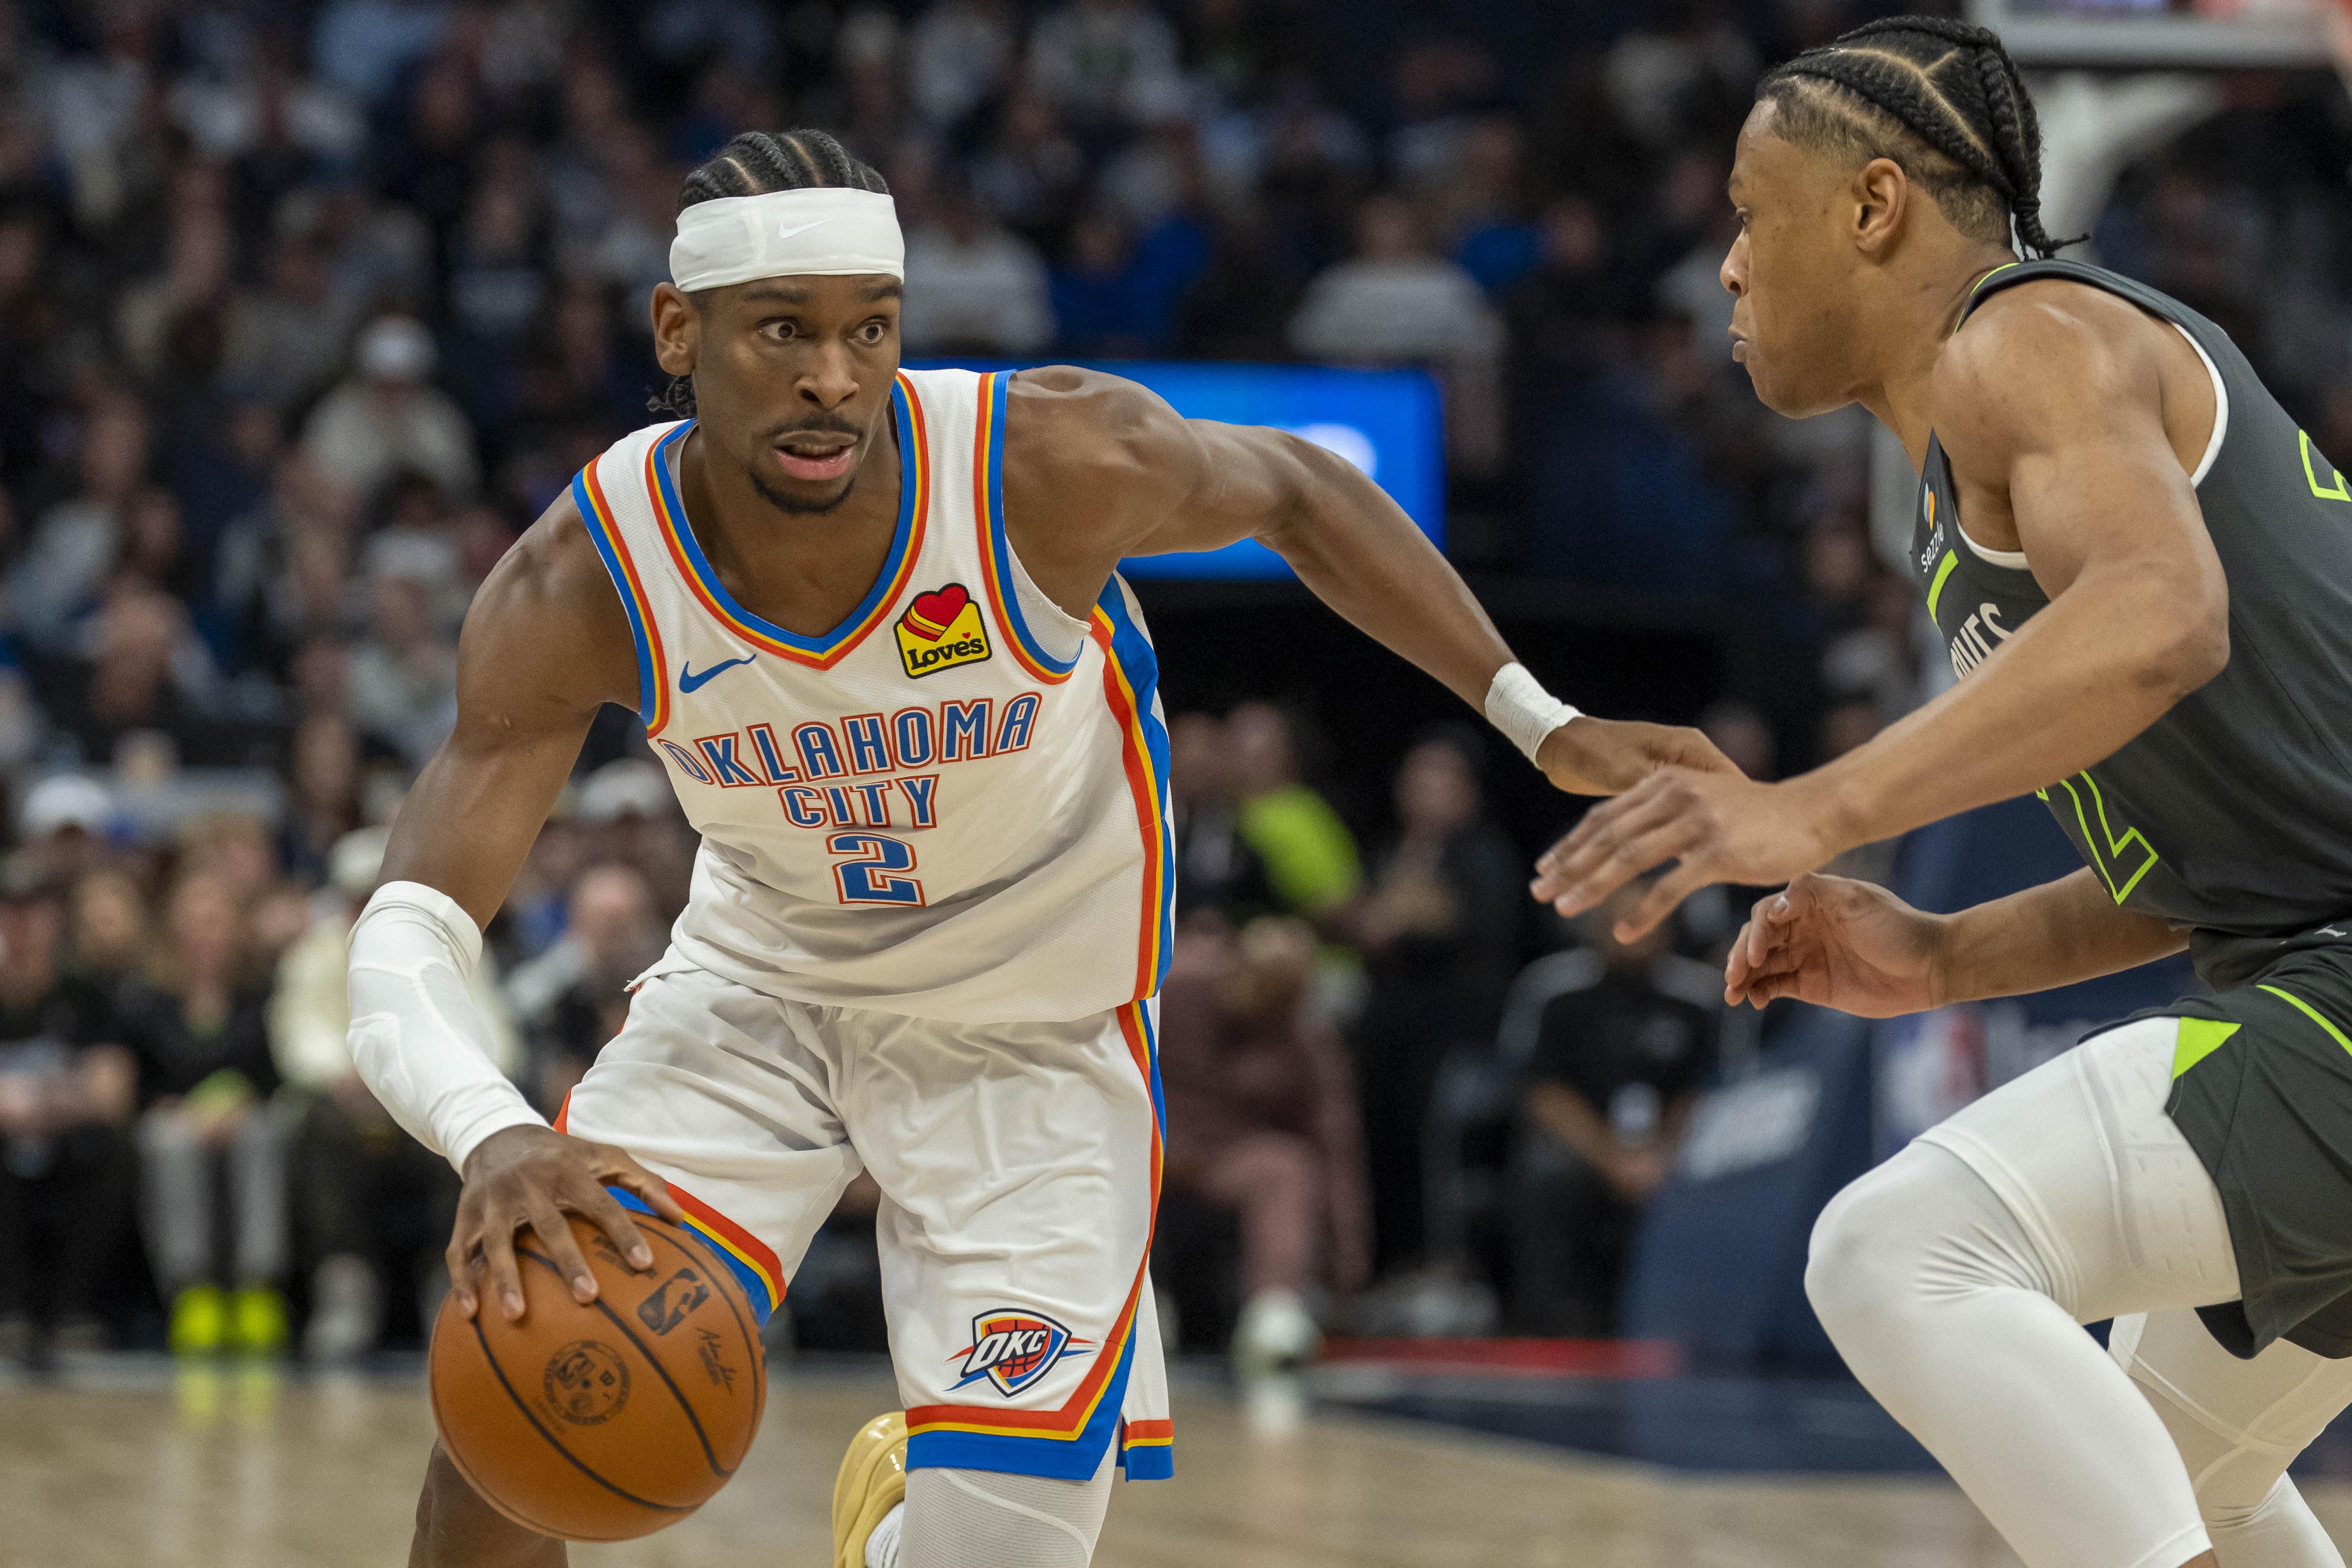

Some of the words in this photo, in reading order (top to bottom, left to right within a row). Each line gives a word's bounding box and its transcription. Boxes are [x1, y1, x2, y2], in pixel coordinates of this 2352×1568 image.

[1921, 520, 1944, 573] sezzle
[657, 692, 1042, 788] OKLAHOMA
[778, 774, 940, 828] CITY
[827, 832, 926, 907] 2
[961, 1329, 1050, 1377] OKC
